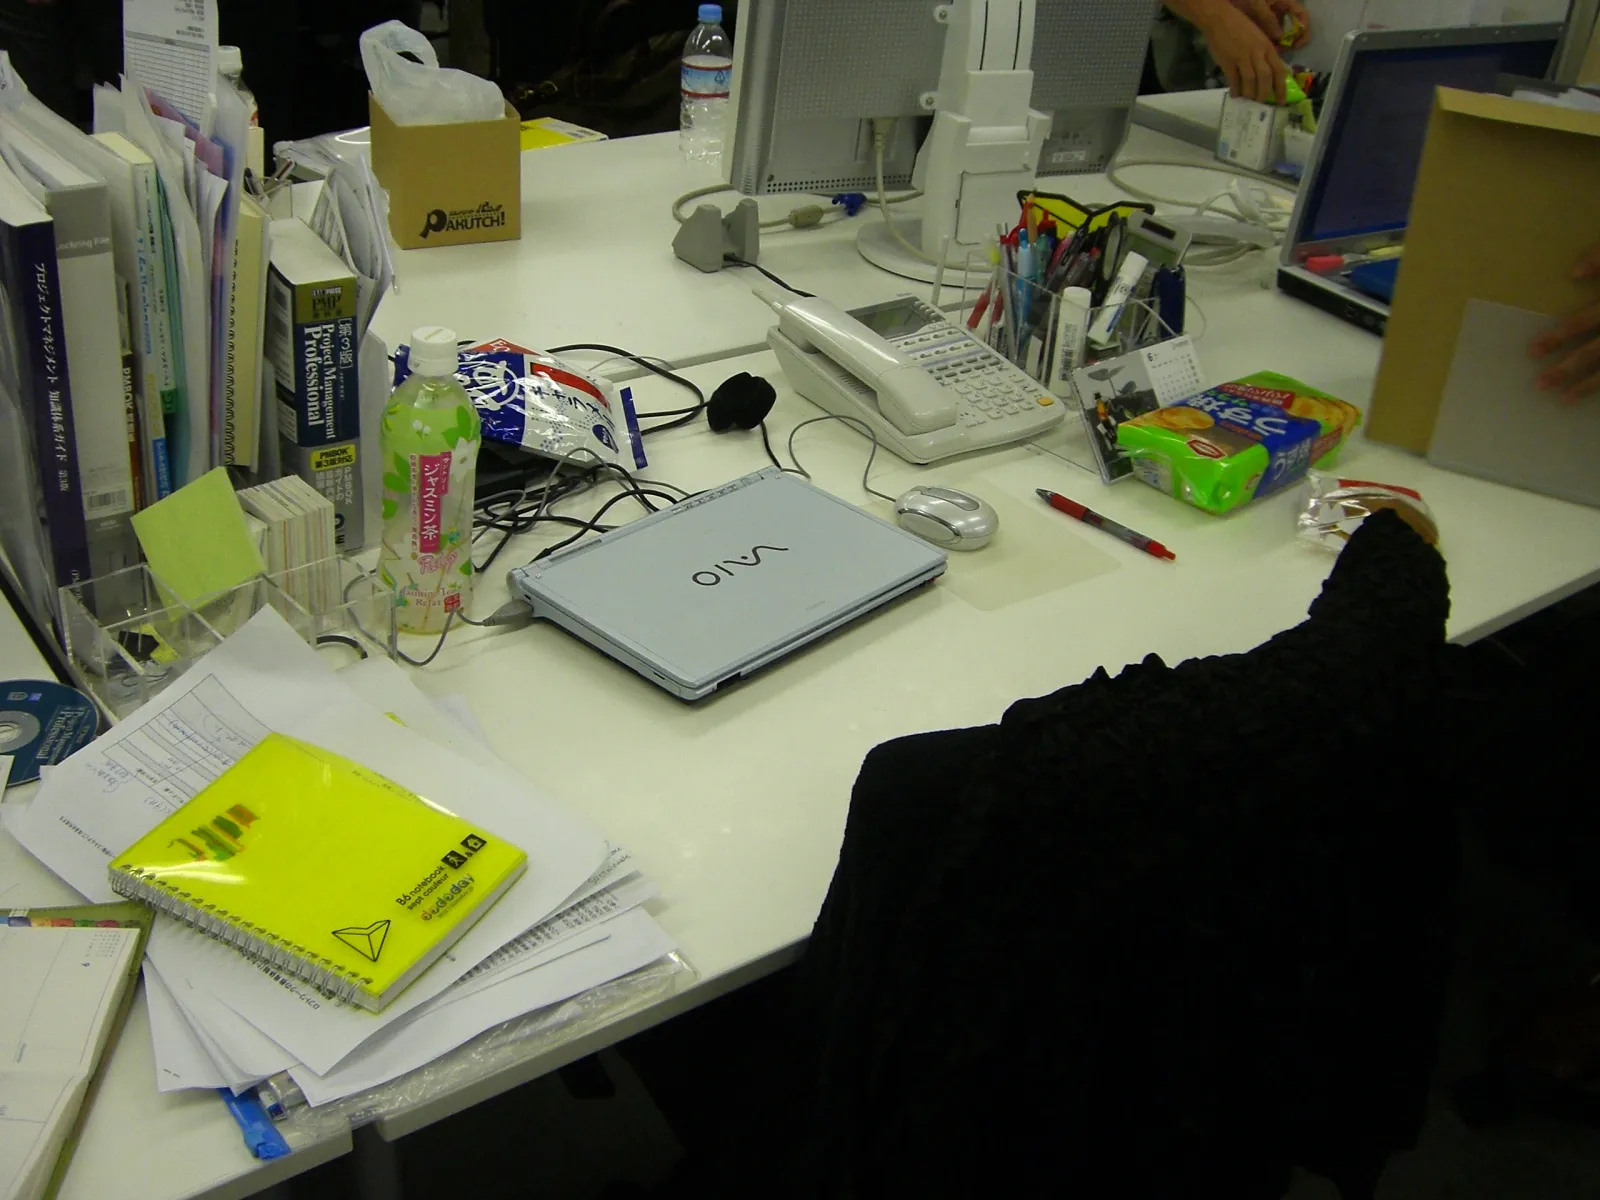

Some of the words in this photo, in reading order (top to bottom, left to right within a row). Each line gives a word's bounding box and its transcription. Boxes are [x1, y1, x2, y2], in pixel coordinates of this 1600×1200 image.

[320, 323, 336, 364] Project
[303, 325, 325, 427] Professional
[322, 366, 337, 439] Management
[421, 462, 440, 541] ジャスミン茶
[692, 544, 789, 586] VAIO
[395, 891, 412, 908] B6
[408, 863, 446, 898] notebook
